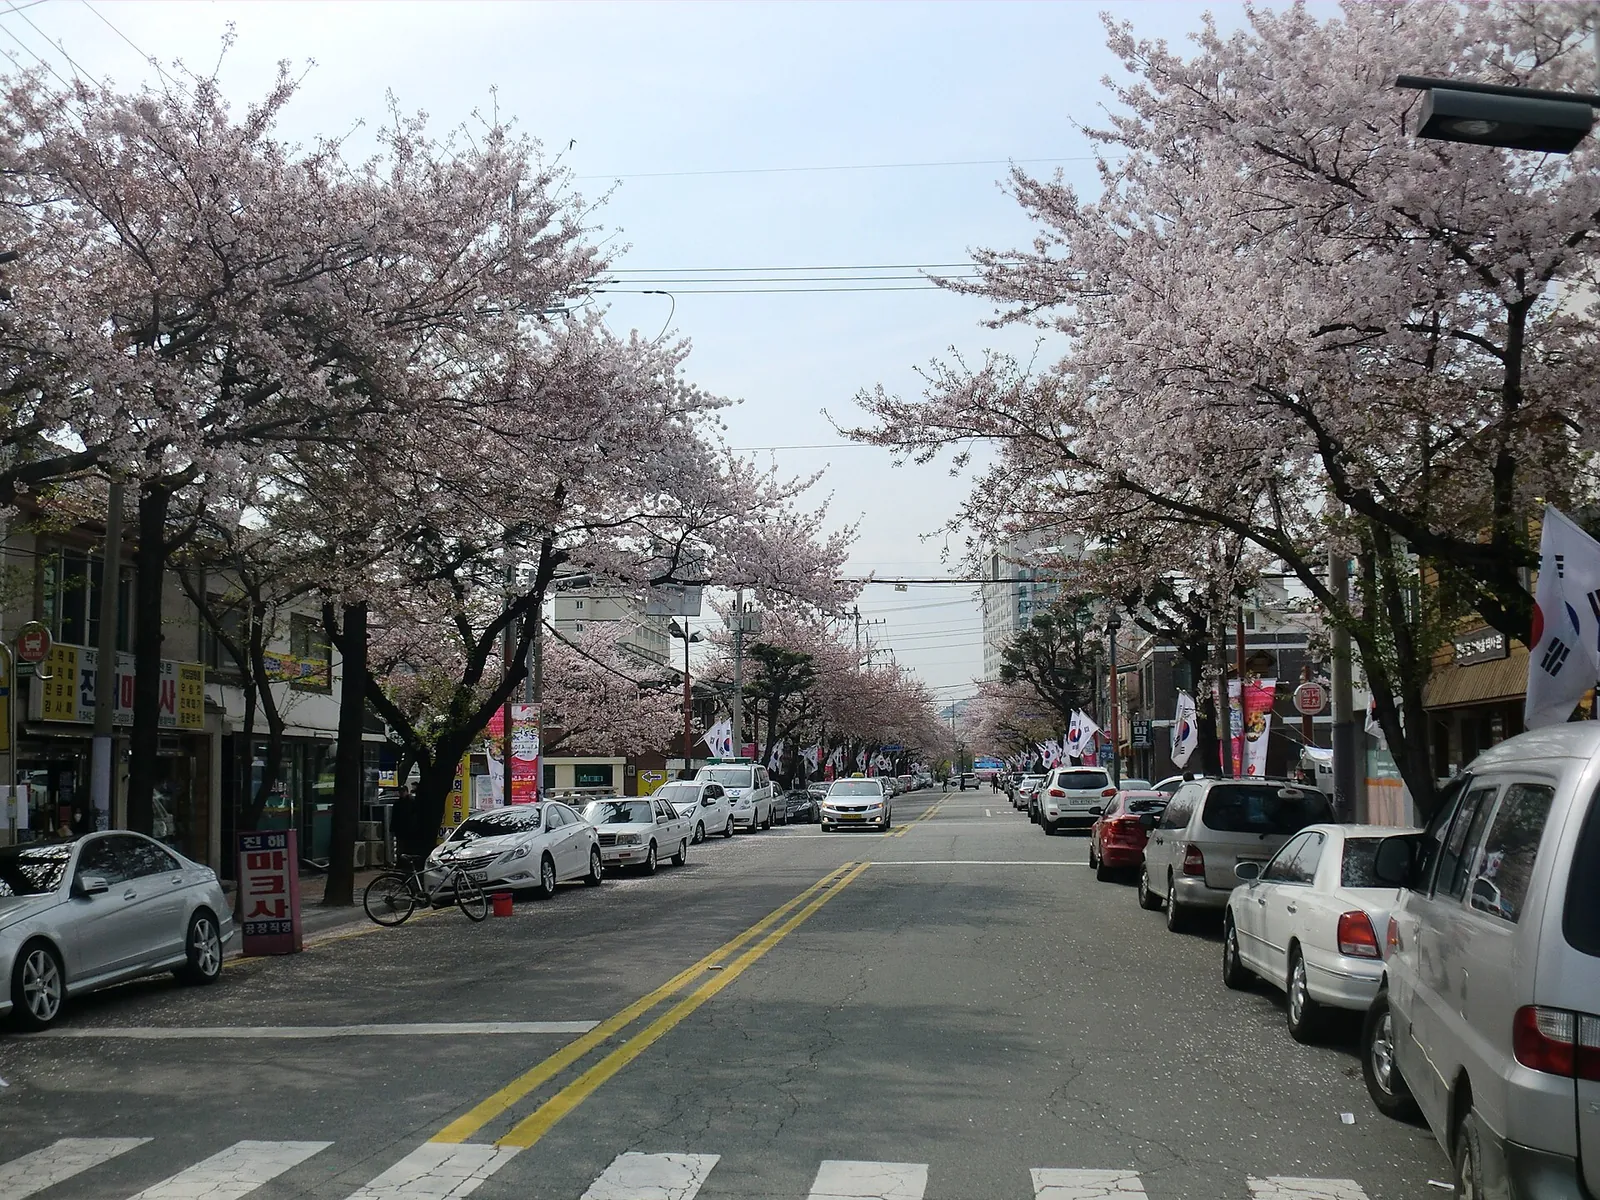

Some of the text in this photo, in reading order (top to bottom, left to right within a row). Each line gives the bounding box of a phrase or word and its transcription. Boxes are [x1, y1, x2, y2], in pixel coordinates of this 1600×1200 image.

[244, 834, 285, 849] 진해
[247, 850, 288, 919] 마크사
[246, 921, 292, 935] 공장직영
